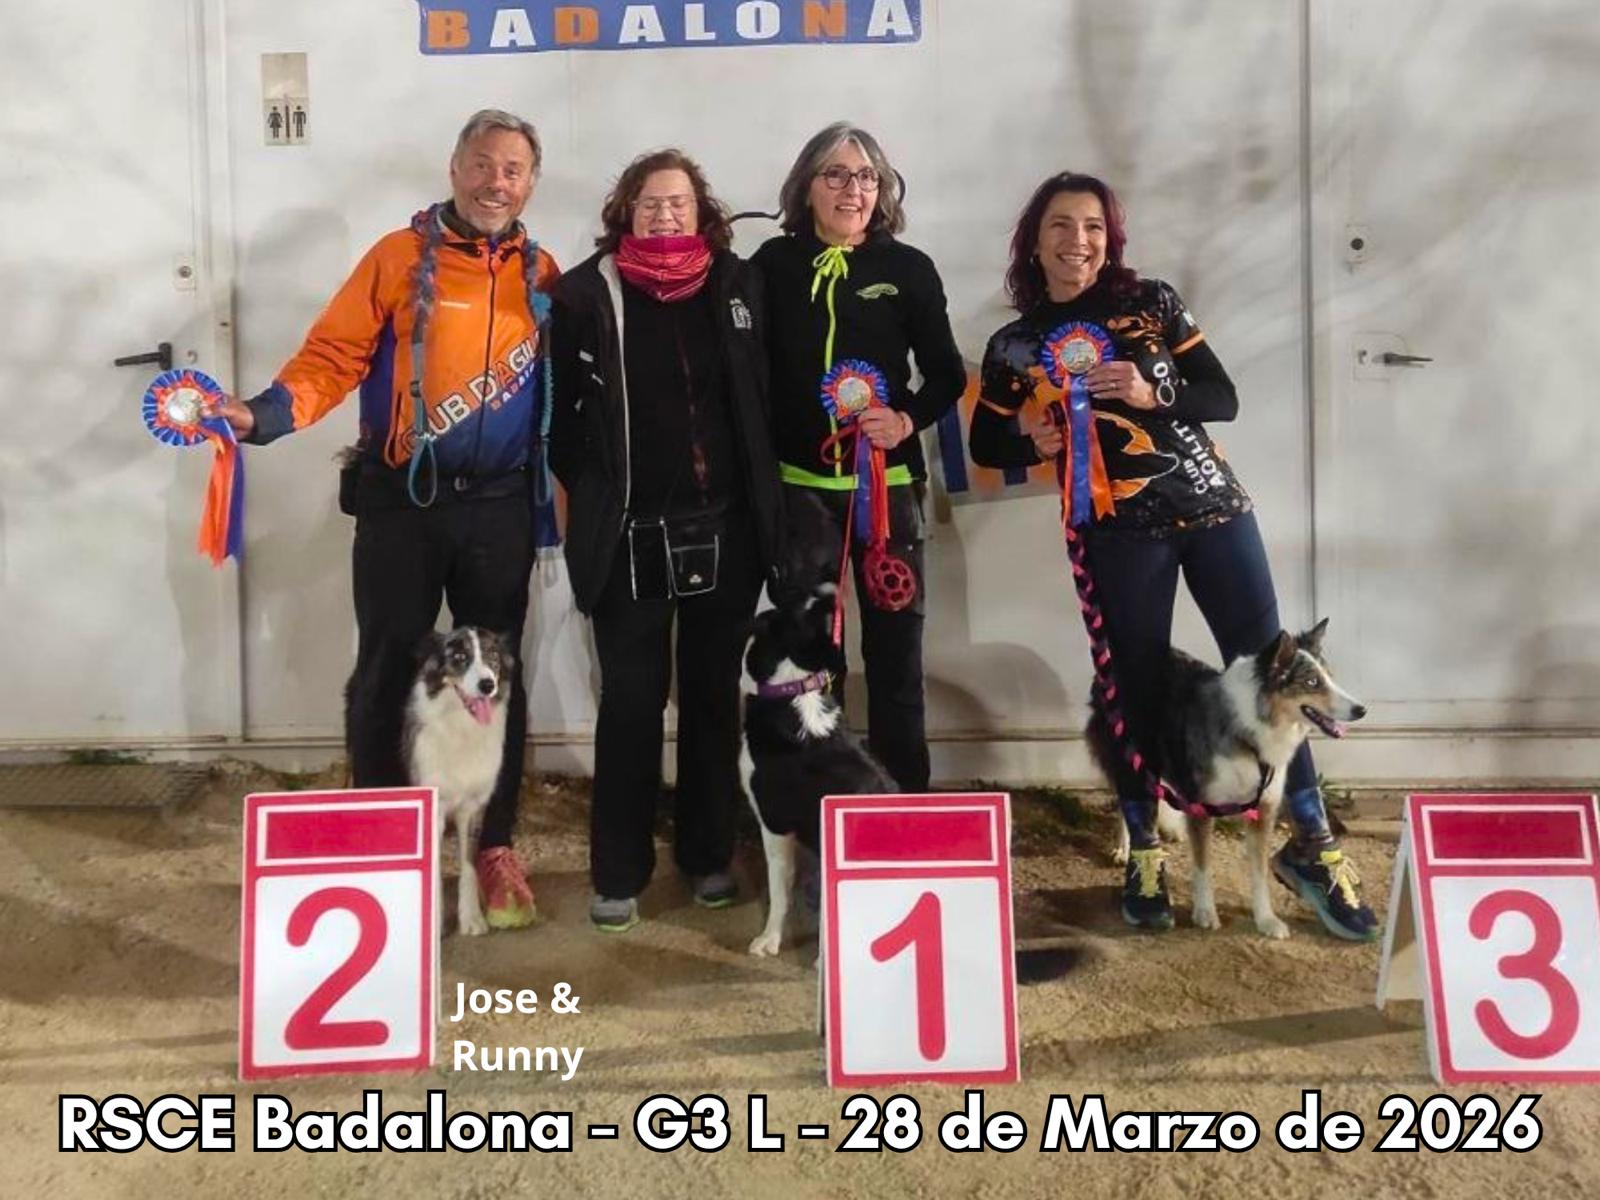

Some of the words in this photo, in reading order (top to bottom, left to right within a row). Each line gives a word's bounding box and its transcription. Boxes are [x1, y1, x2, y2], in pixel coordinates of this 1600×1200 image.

[427, 0, 915, 49] BADALONA
[1183, 459, 1209, 494] CLUB
[285, 888, 389, 1050] 2
[870, 891, 946, 1061] 1
[1469, 889, 1580, 1060] 3
